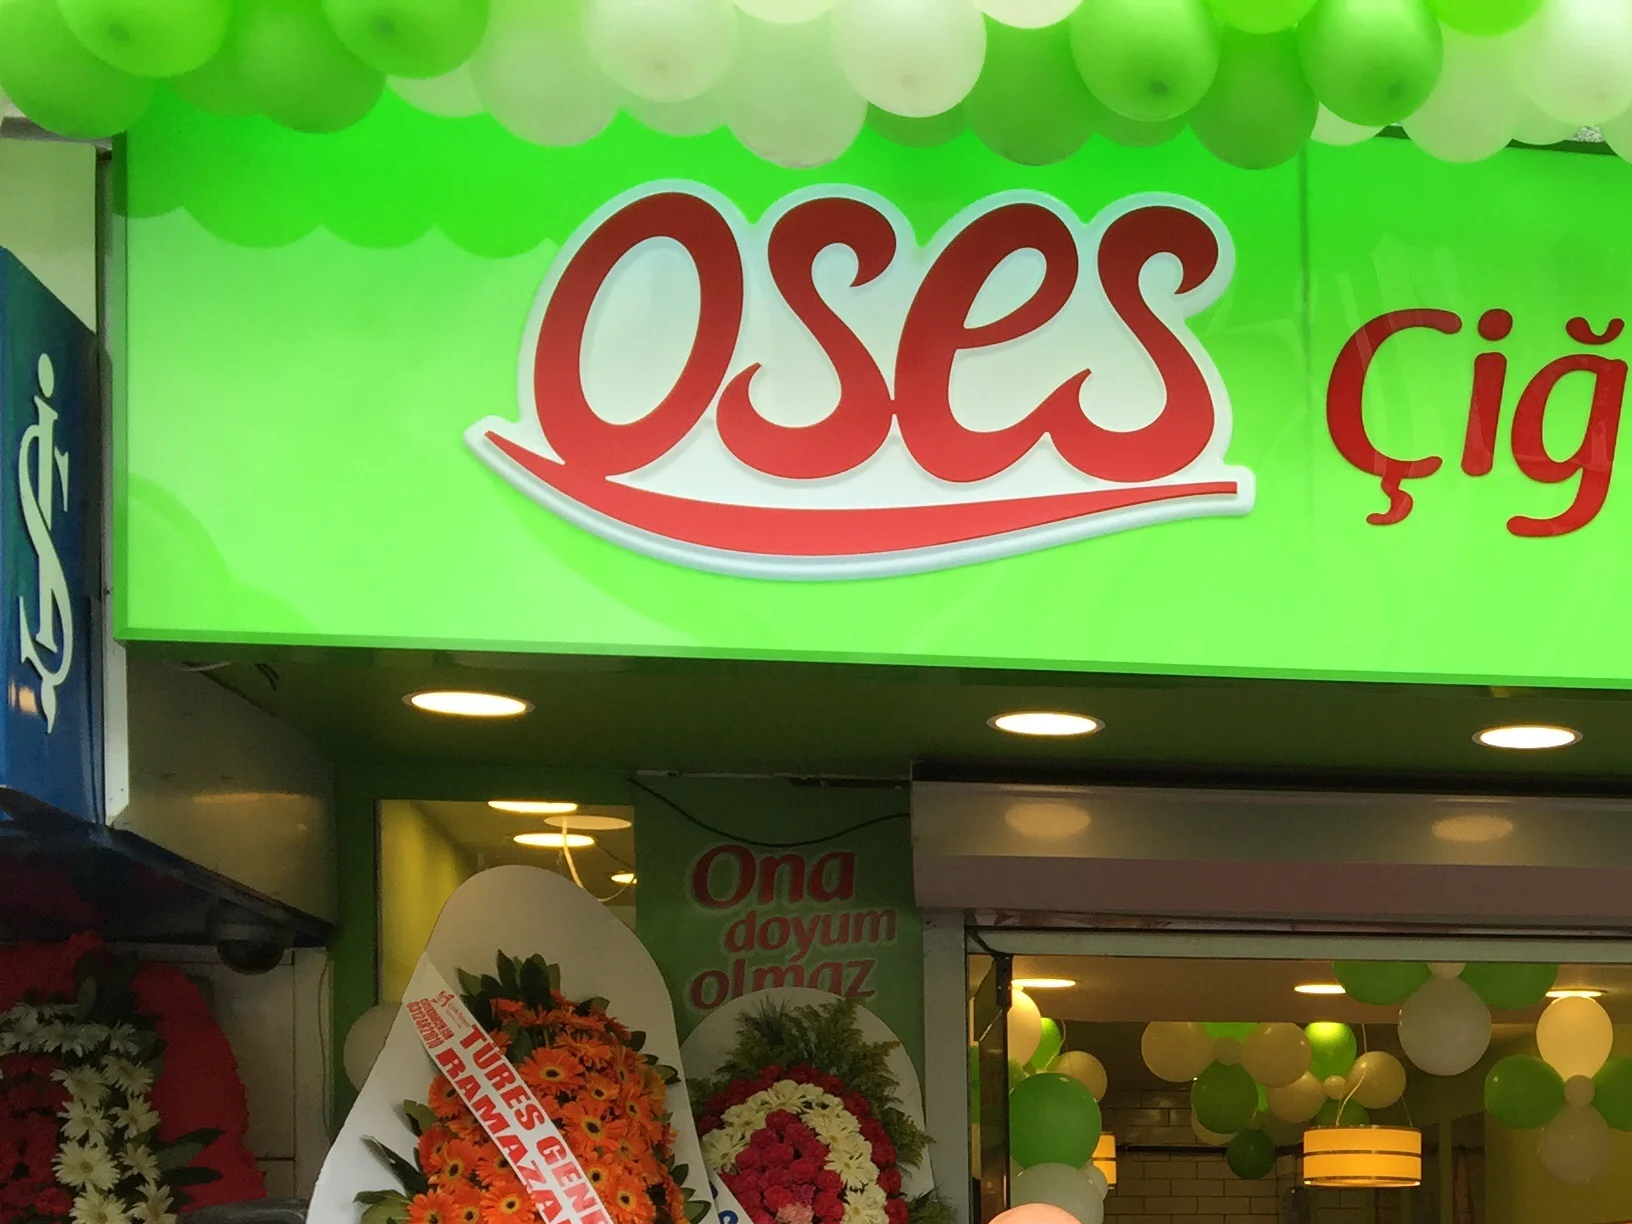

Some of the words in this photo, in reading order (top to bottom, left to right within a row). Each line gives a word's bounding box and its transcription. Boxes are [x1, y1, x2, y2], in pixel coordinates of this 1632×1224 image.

[1326, 308, 1629, 538] Çiğ
[691, 844, 856, 910] Ona
[724, 909, 897, 963] doyum
[690, 958, 876, 1011] olmaz
[458, 1024, 545, 1131] TÜRES
